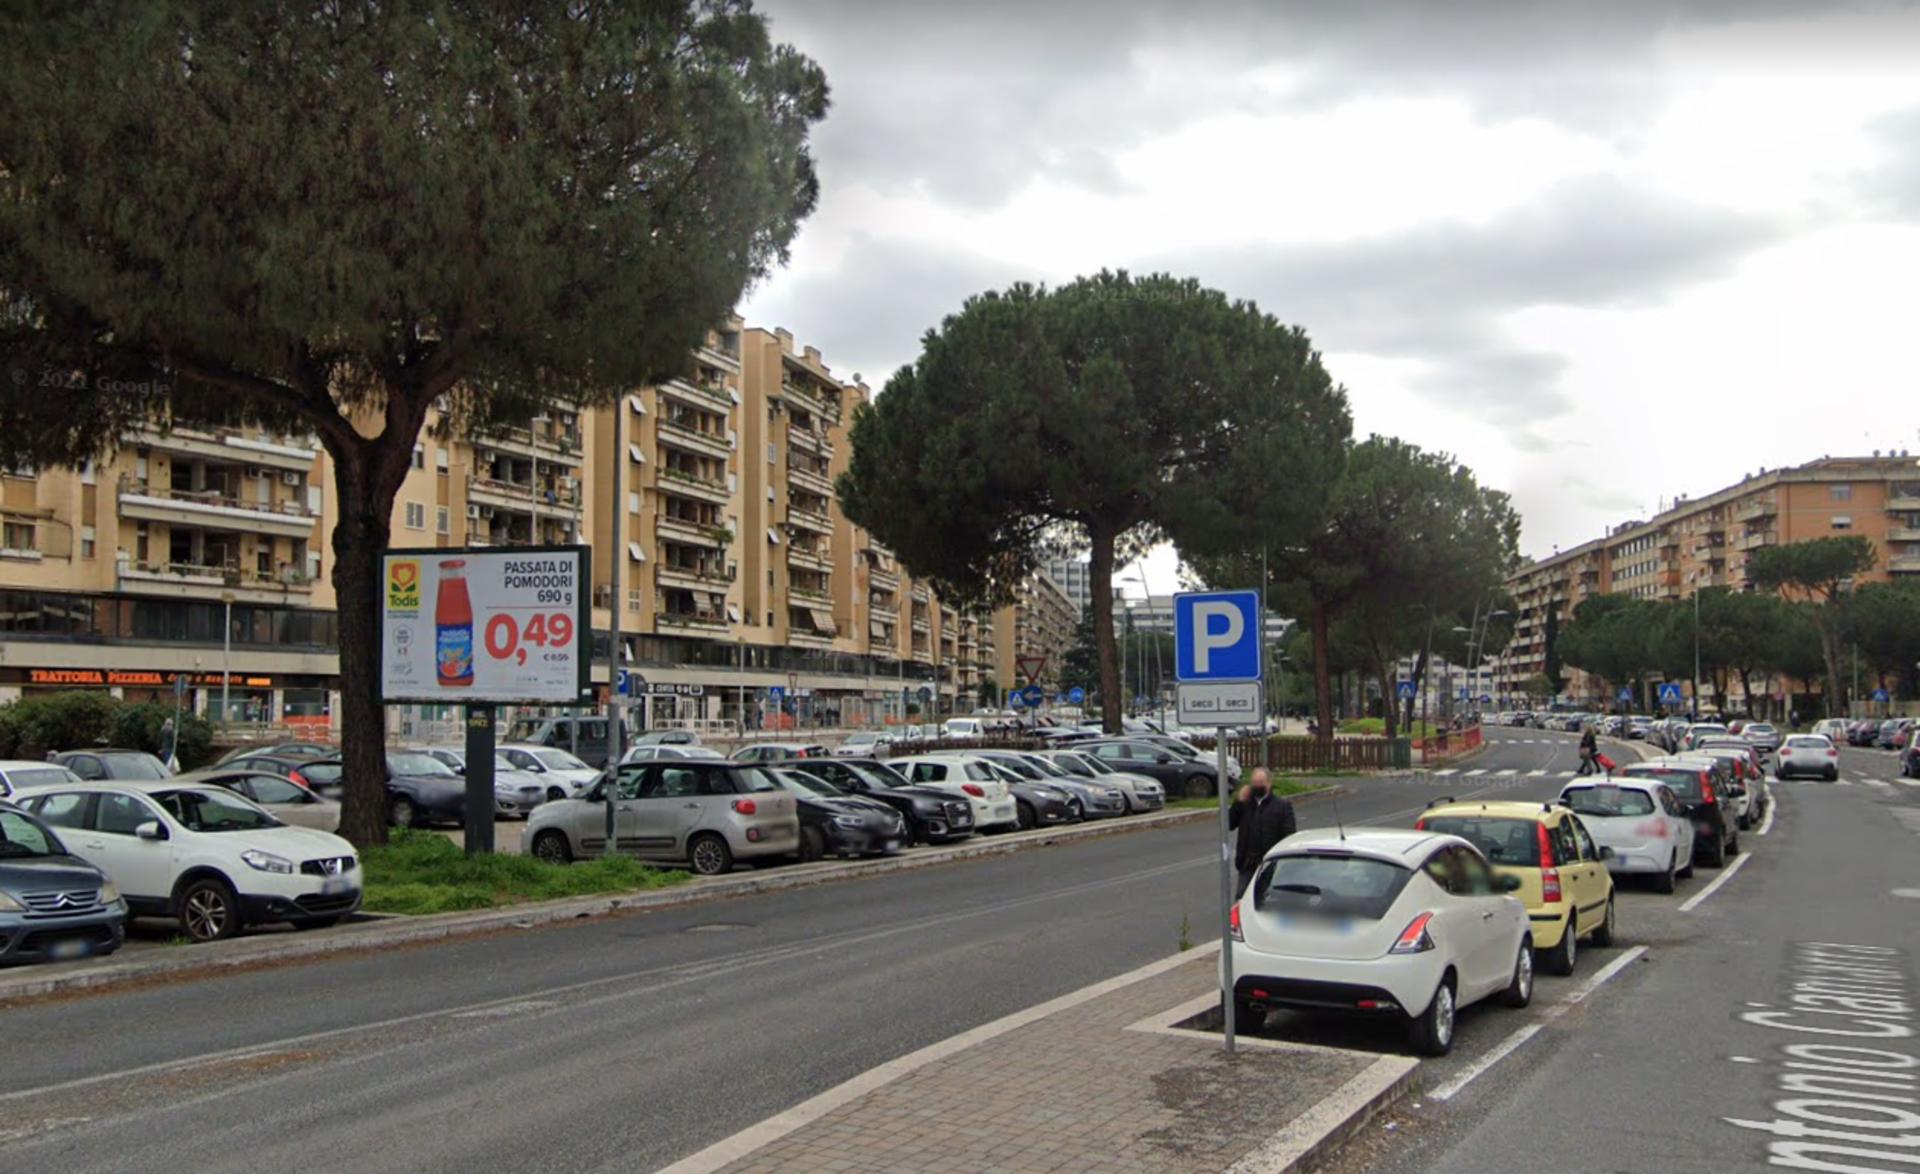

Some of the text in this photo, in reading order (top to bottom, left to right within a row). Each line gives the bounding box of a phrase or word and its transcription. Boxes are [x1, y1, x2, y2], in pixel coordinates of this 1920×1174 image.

[504, 561, 572, 573] PASSATA DI
[504, 575, 572, 588] POMODORI
[389, 595, 419, 607] Todis
[538, 590, 572, 605] 690 g
[484, 613, 573, 666] 0,49
[1192, 601, 1244, 673] P
[30, 670, 103, 683] TRATTORIA
[108, 671, 163, 684] PIZZERIA
